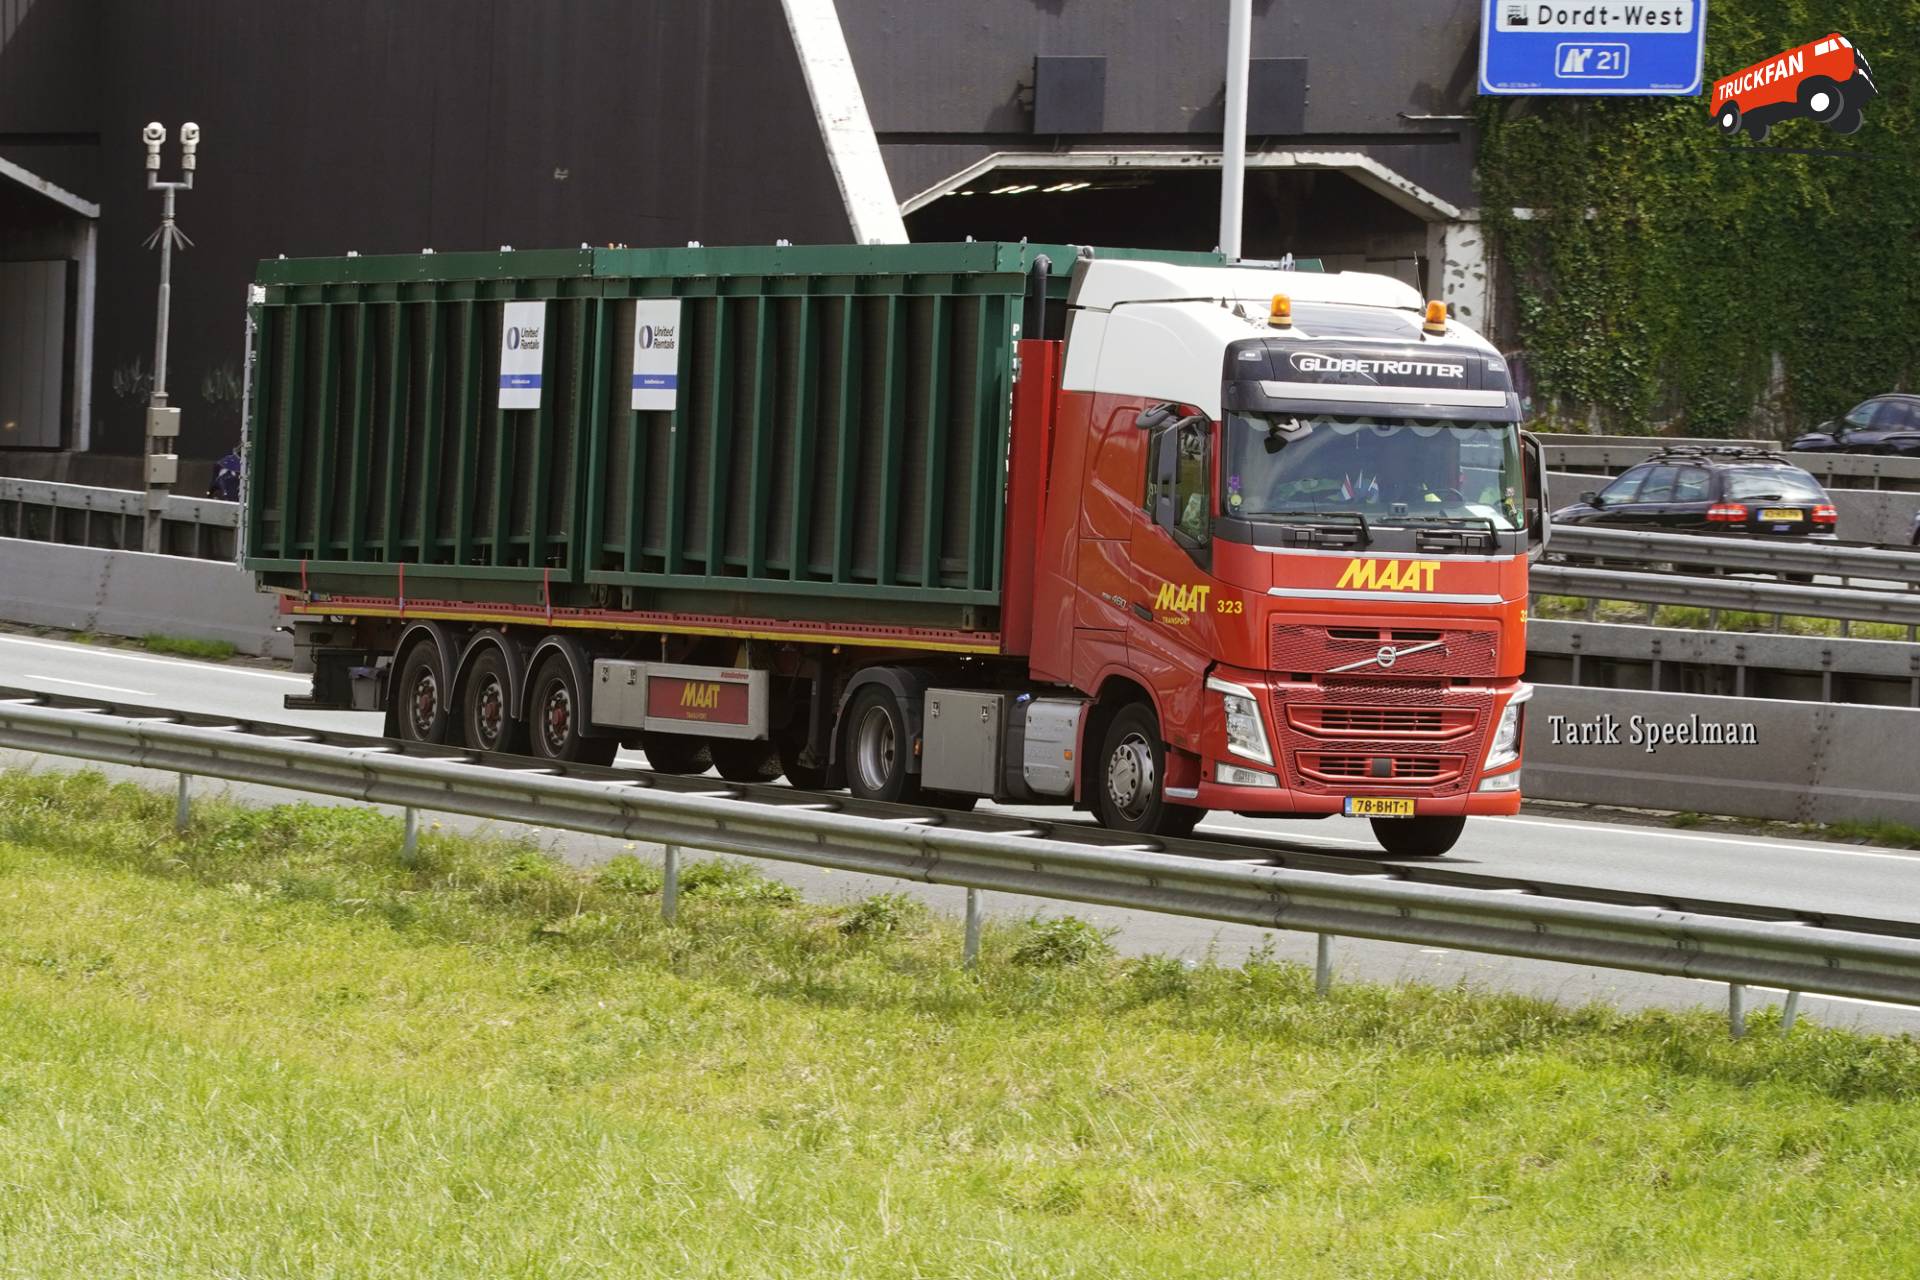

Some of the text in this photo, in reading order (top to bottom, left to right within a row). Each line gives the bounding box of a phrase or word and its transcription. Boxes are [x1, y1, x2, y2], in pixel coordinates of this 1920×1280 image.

[1537, 5, 1684, 26] Dordt-West
[1596, 51, 1621, 70] 21
[520, 327, 540, 338] United
[653, 325, 675, 337] United
[520, 339, 540, 350] Rentals
[652, 338, 675, 350] Rentals
[1299, 357, 1464, 378] GLOBETROTTER
[1336, 558, 1441, 592] MAAT
[1154, 582, 1211, 613] MAAT
[1216, 600, 1243, 614] 323
[680, 682, 721, 709] MAAT
[1356, 799, 1409, 813] 78-BHT-1
